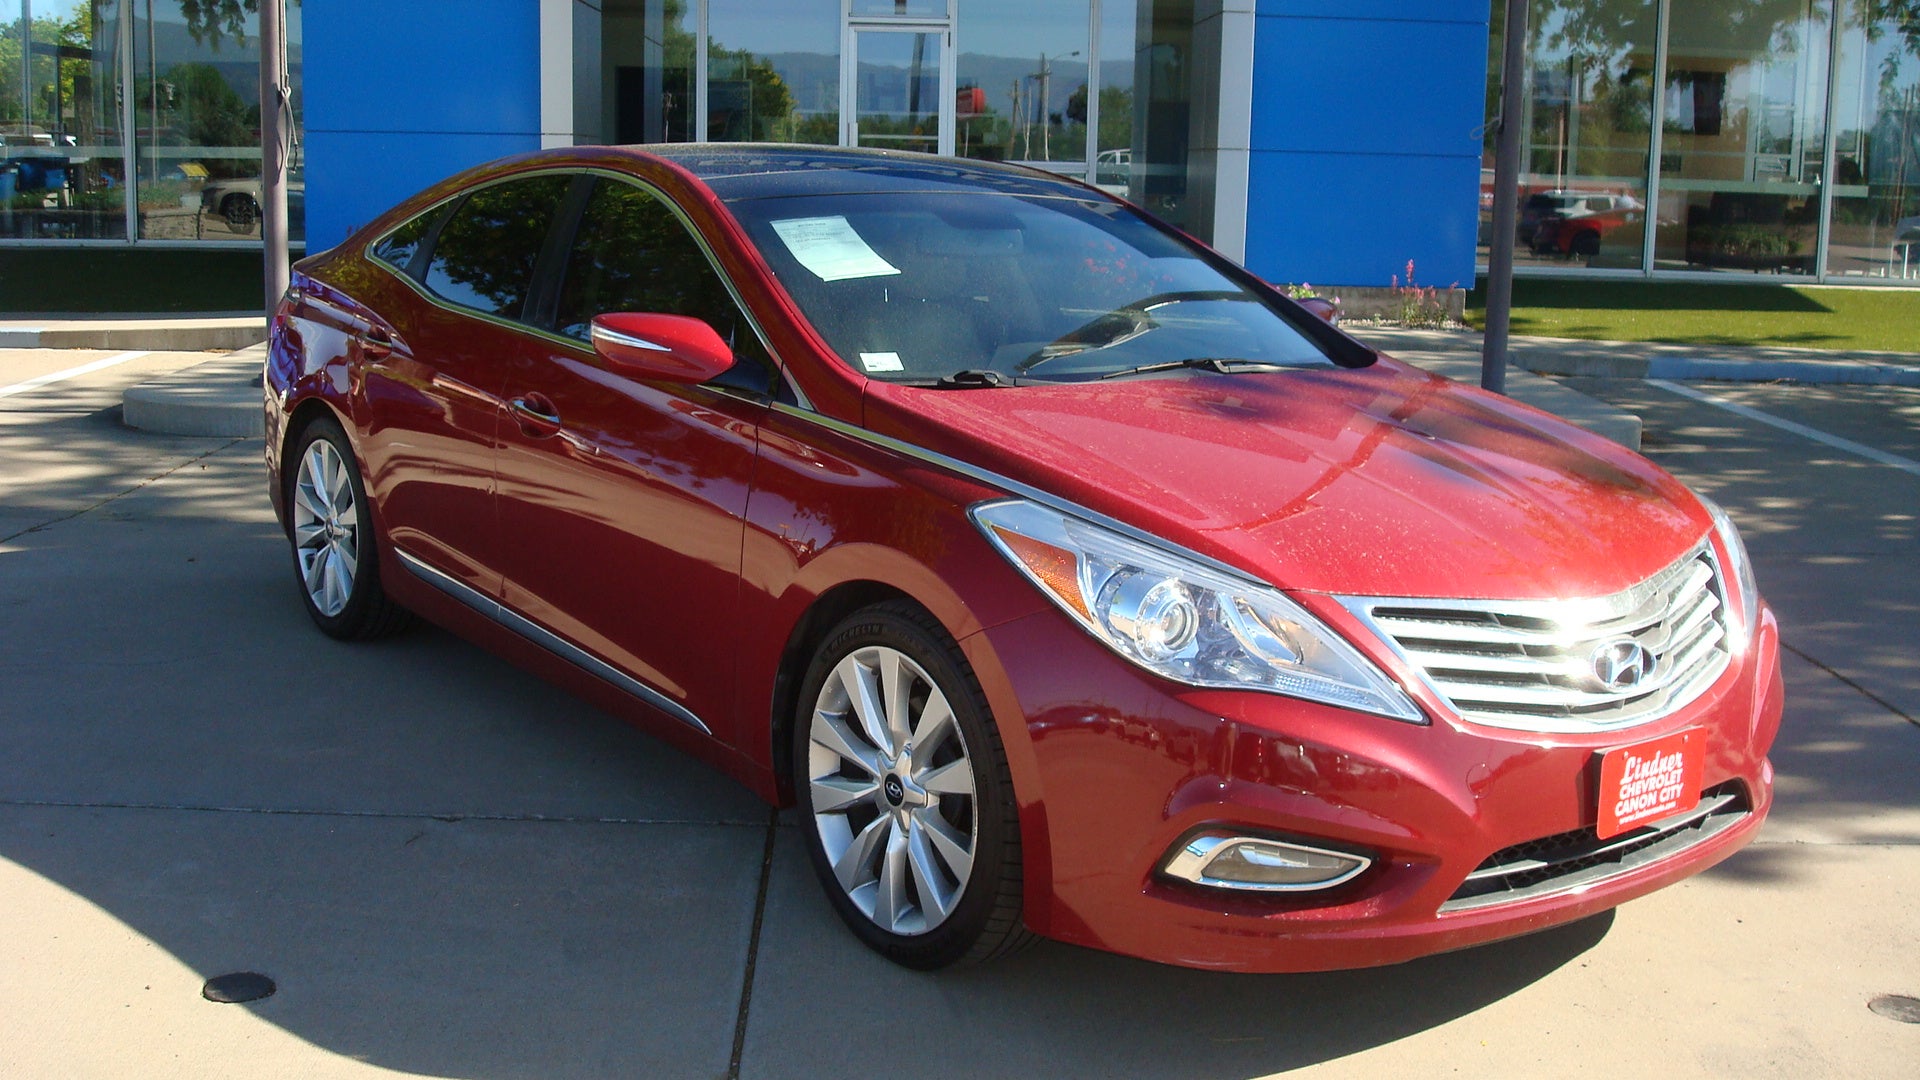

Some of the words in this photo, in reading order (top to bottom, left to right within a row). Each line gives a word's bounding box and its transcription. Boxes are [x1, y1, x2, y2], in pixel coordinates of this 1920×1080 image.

[829, 624, 880, 651] MICHELIN
[1620, 750, 1683, 785] Lindner
[1615, 791, 1657, 817] CANON
[1659, 782, 1684, 803] CITY
[1619, 769, 1683, 800] CHEVROLET
